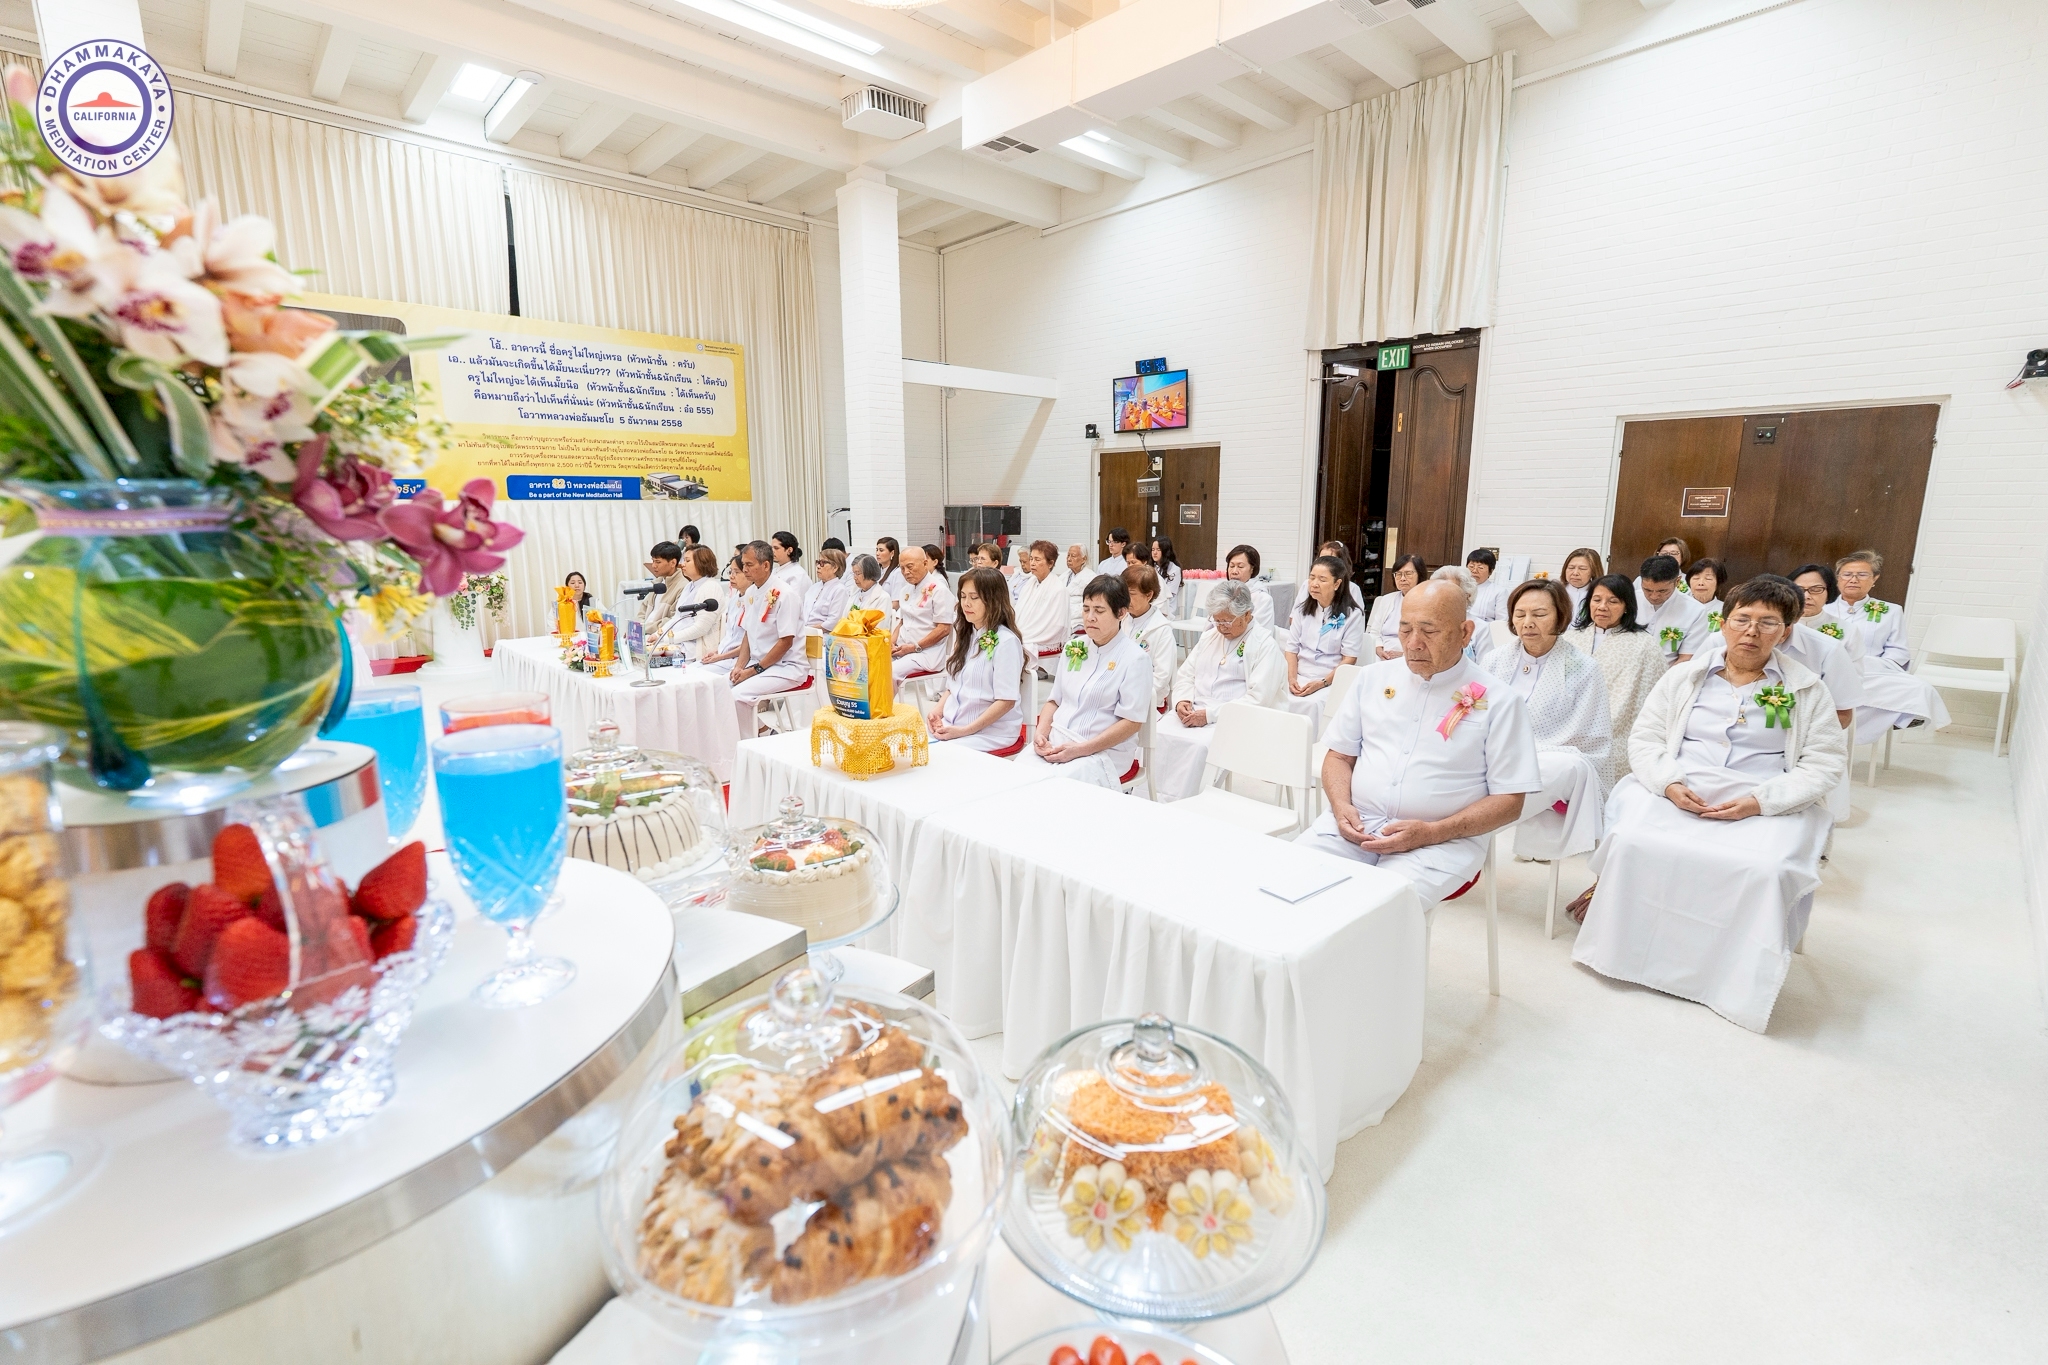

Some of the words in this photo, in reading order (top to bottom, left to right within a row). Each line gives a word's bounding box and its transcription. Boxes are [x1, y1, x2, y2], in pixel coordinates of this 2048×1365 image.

[1381, 347, 1407, 369] EXIT
[517, 407, 614, 424] โอวาทหลวงพ่อธัมมชโย
[619, 416, 625, 424] 5
[627, 415, 659, 426] ธันวาคม
[661, 419, 683, 428] 2558
[696, 406, 714, 416] 555)
